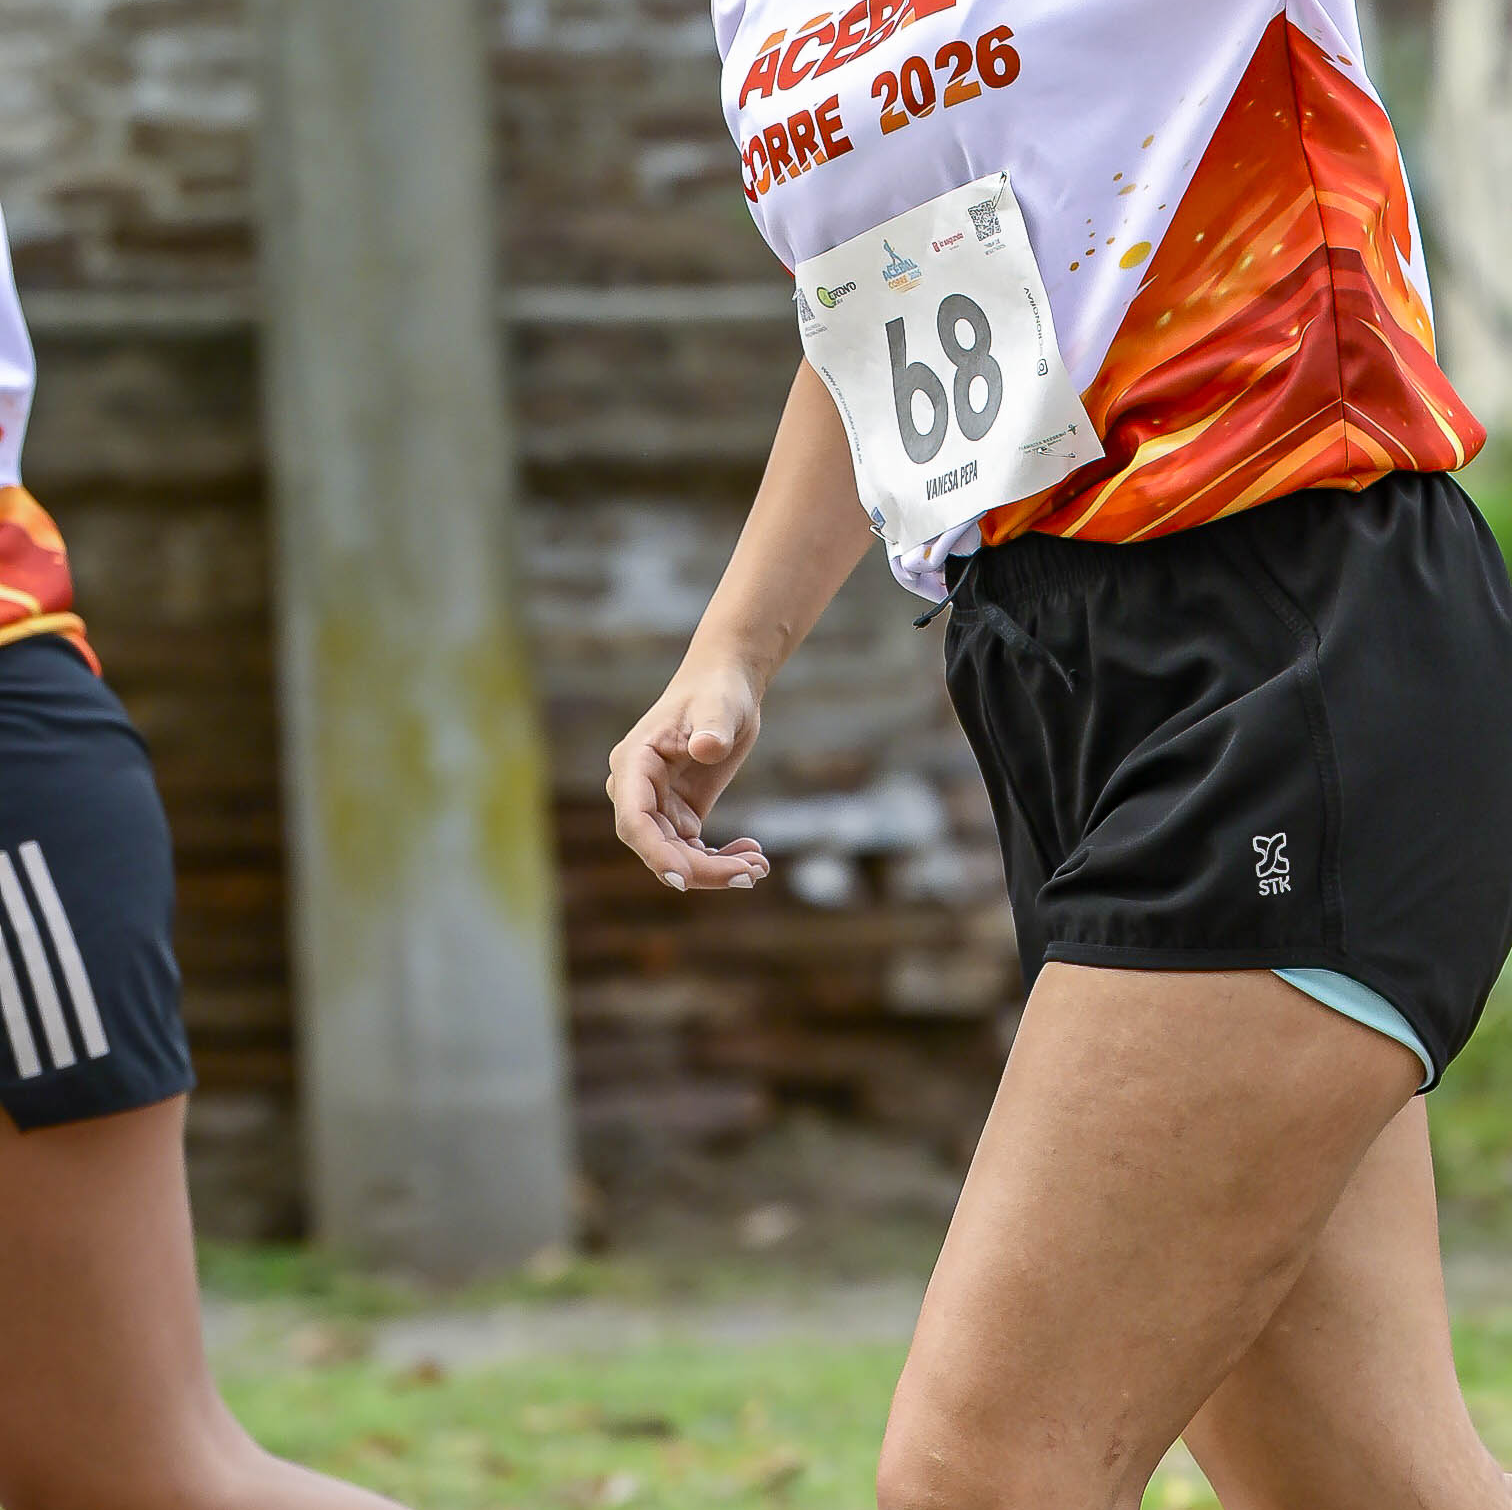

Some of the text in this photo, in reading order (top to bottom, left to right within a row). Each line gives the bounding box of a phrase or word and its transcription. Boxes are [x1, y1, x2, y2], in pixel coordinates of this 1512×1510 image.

[871, 25, 1021, 136] 2026
[885, 294, 1003, 464] 68
[926, 459, 978, 501] VANESA PEPA
[1259, 875, 1291, 896] STK
